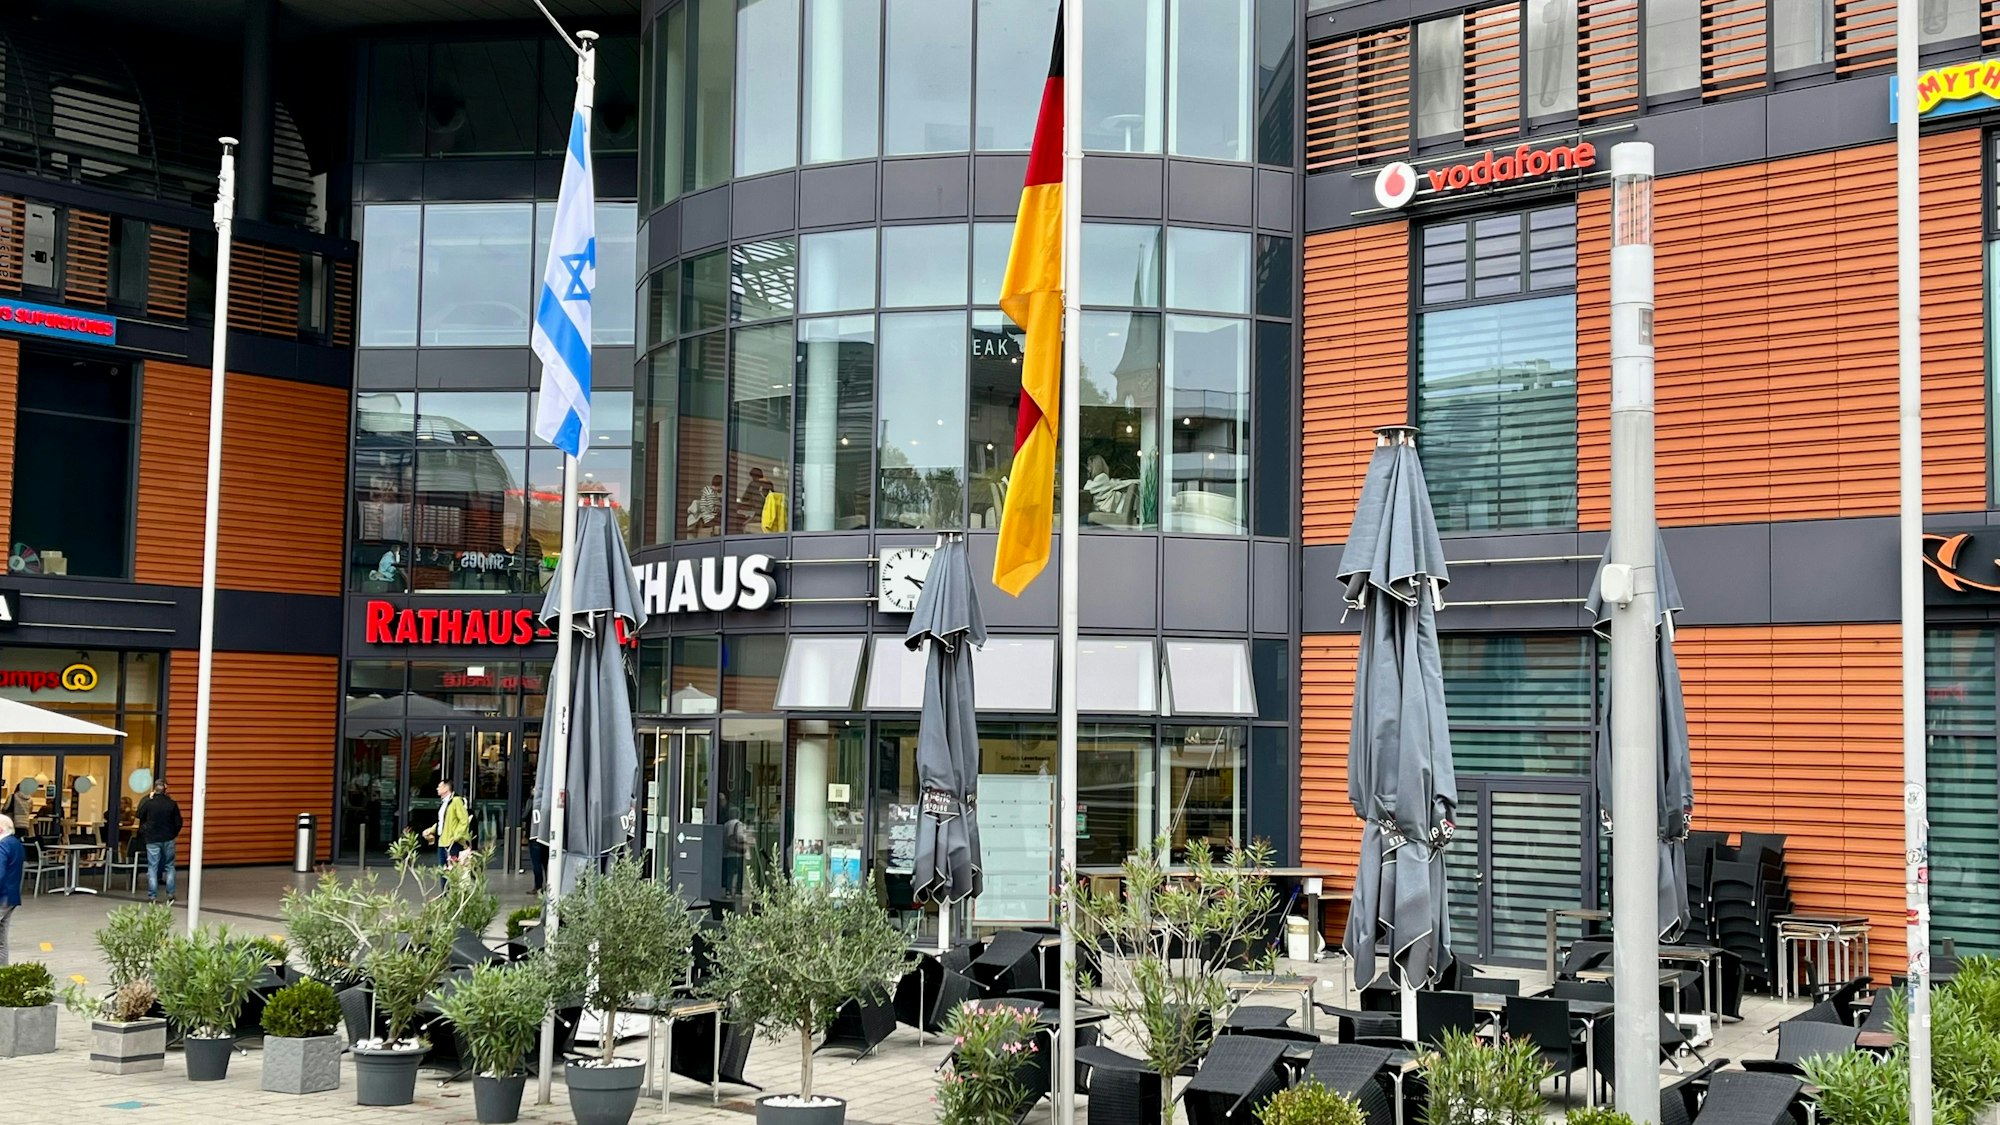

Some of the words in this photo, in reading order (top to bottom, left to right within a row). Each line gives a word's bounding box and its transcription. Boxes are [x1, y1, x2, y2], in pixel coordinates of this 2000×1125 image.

[1918, 66, 2000, 103] MYTH
[1428, 142, 1596, 192] vodafone
[15, 307, 114, 337] SUPERSTORES
